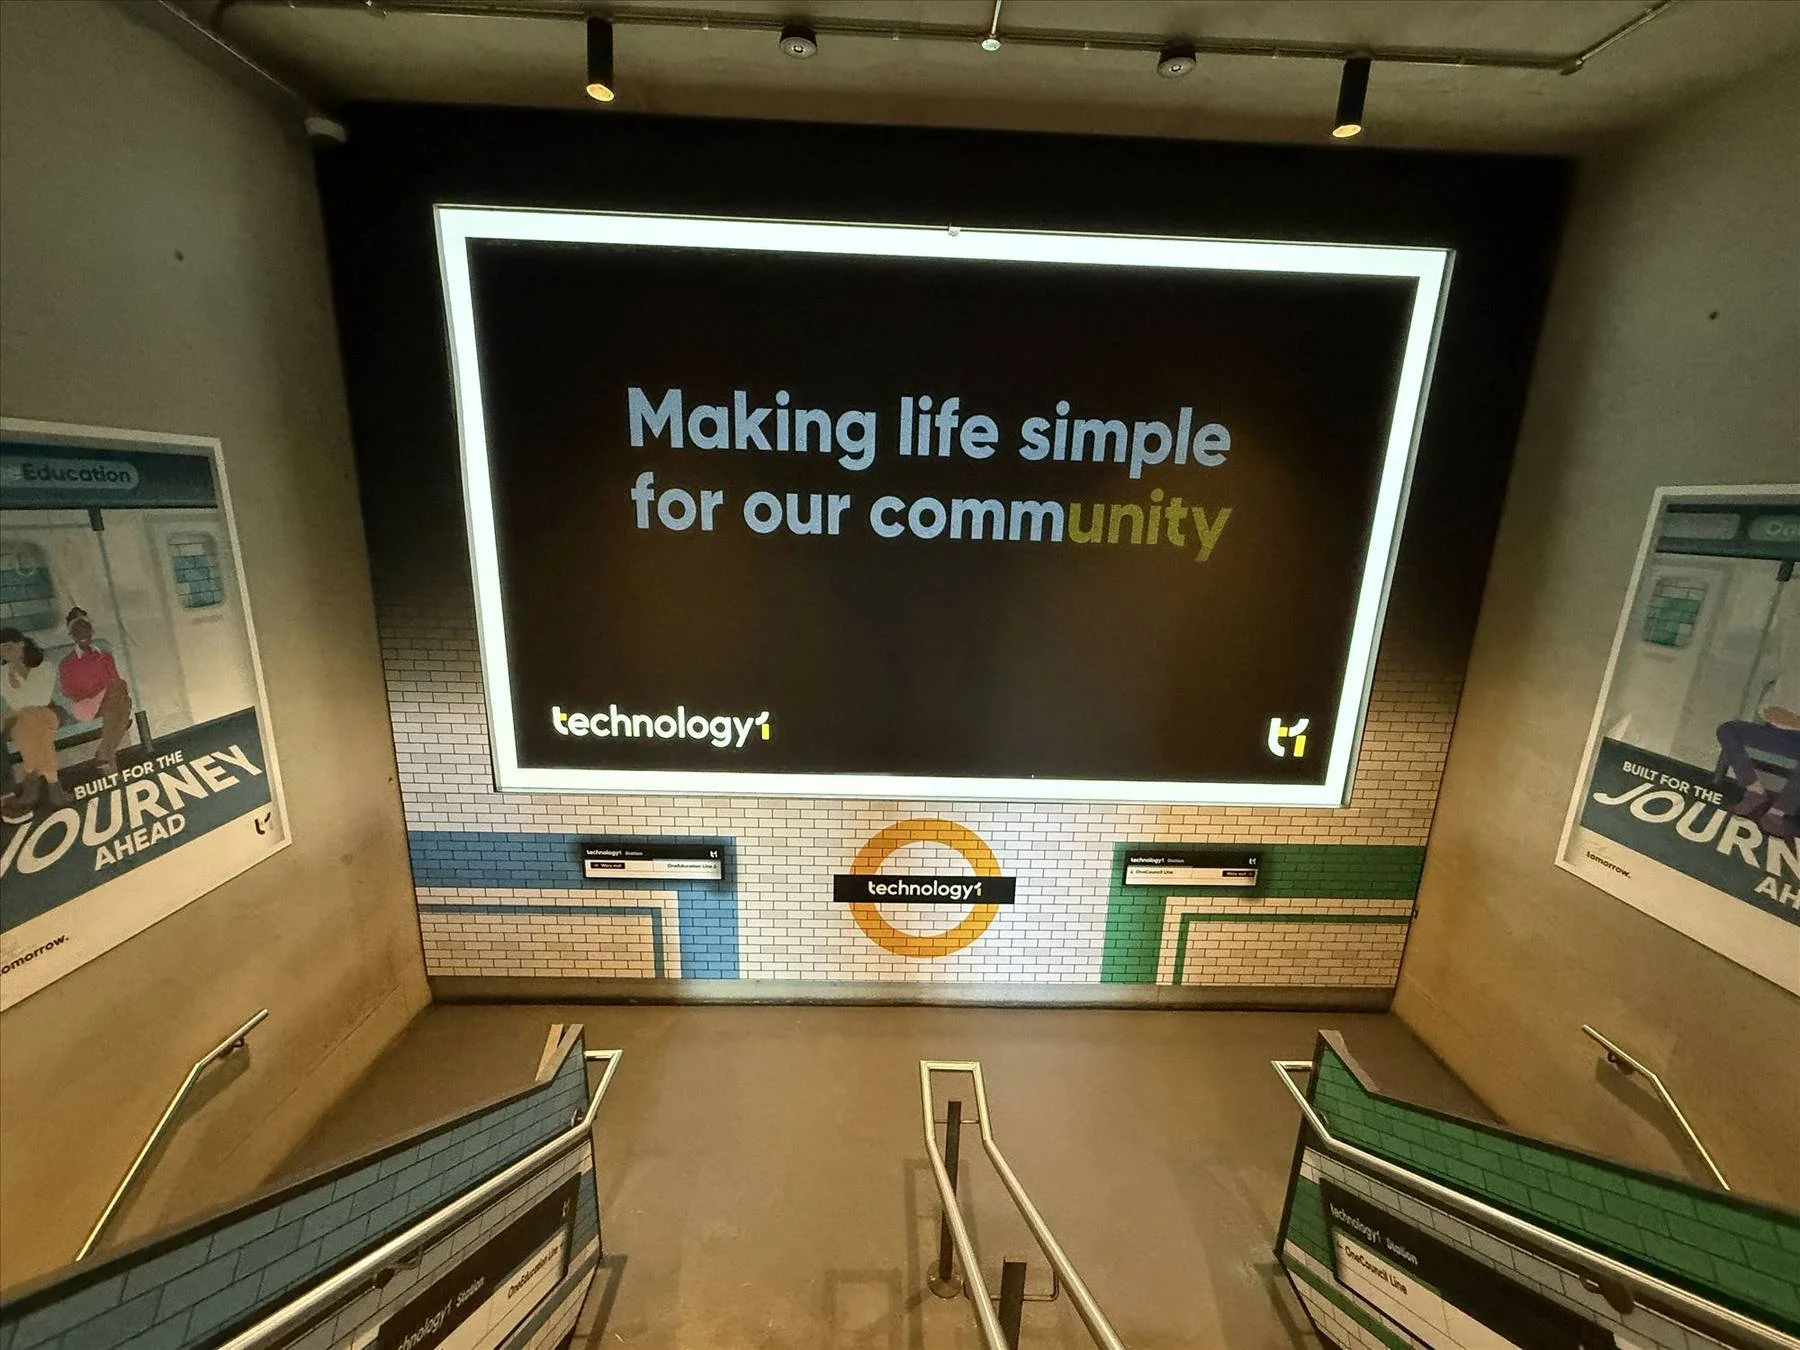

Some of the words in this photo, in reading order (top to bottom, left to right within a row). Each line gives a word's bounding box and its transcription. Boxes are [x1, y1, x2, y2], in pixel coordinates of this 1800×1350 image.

[628, 387, 876, 471] Making
[899, 395, 999, 460] life
[1018, 400, 1232, 480] simple
[631, 471, 724, 531] for
[743, 491, 850, 535] our
[869, 488, 1232, 562] community
[552, 703, 770, 748] technology1
[74, 773, 118, 800] BUILT
[122, 761, 154, 783] FOR
[156, 750, 184, 769] THE
[1622, 760, 1659, 780] BUILT
[1660, 774, 1691, 793] FOR
[1693, 785, 1724, 805] THE
[94, 813, 186, 871] AHEAD
[1586, 851, 1631, 879] tomorrow.
[868, 879, 982, 900] technology1
[0, 935, 69, 977] omorrow.
[1345, 1245, 1389, 1283] OneCouncil
[1388, 1273, 1408, 1295] Line
